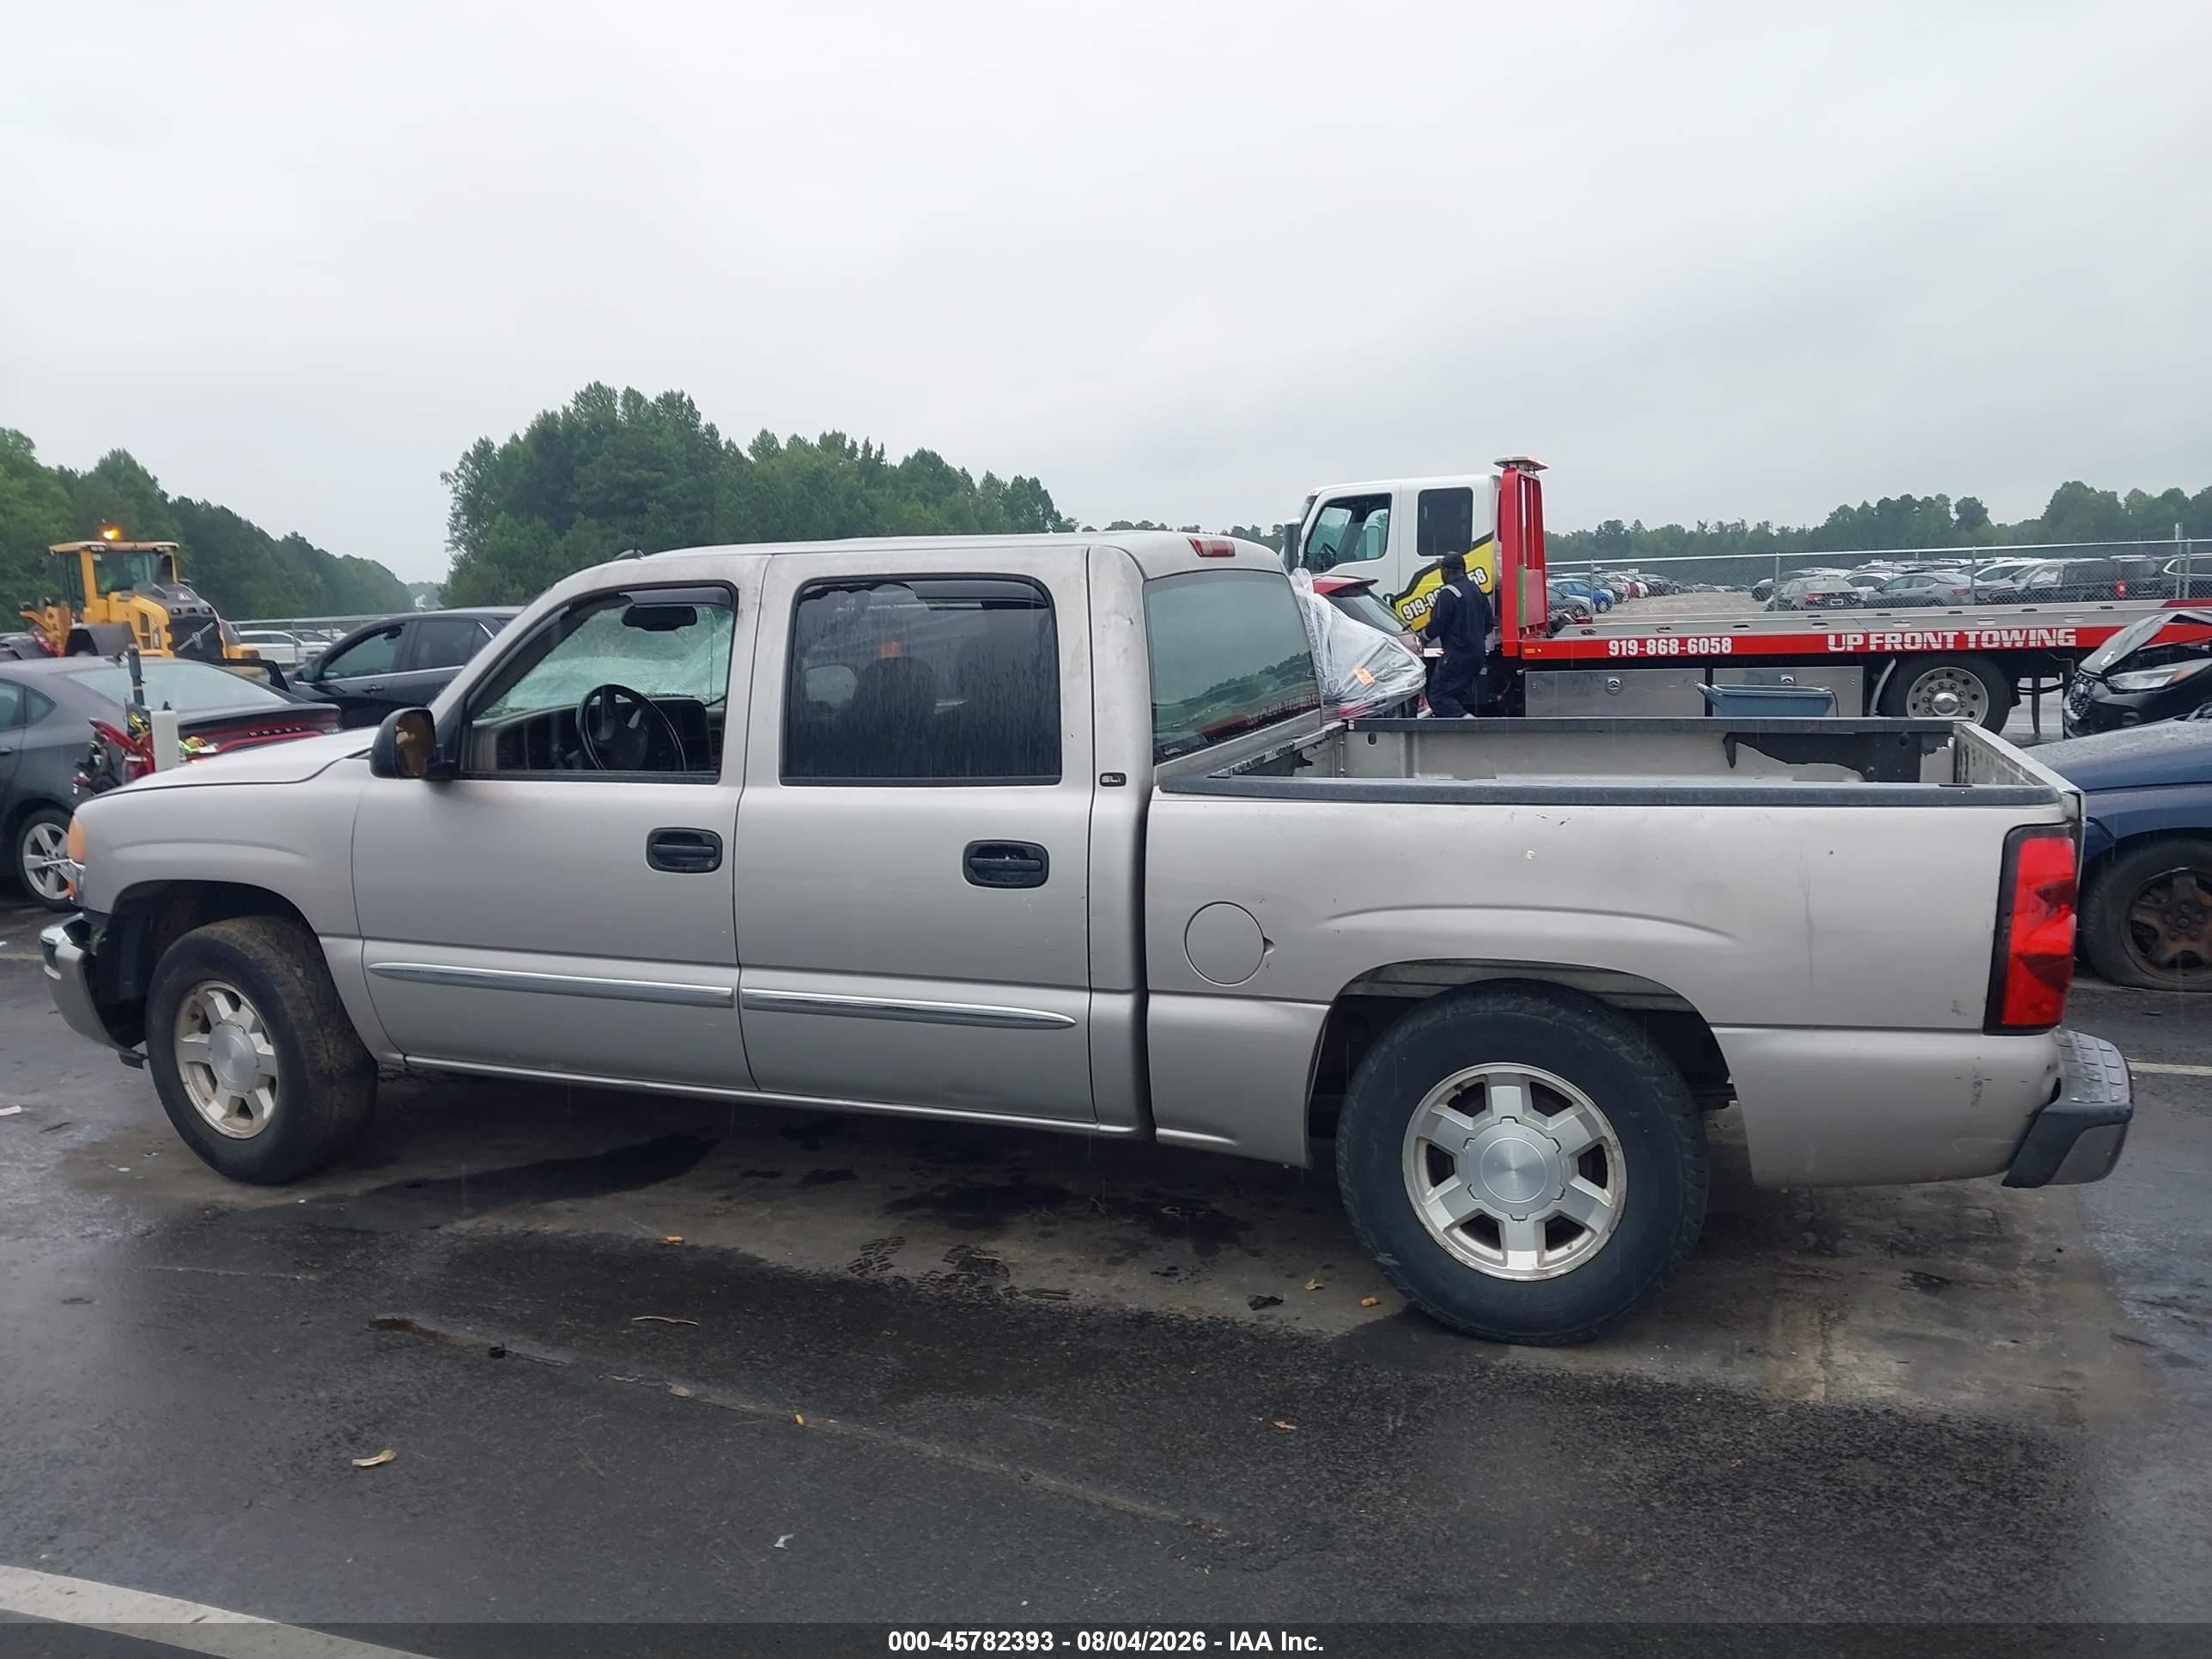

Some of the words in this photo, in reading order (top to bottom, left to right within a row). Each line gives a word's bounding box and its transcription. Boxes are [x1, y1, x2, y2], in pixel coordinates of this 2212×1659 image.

[1608, 636, 1733, 656] 919-868-6058
[1827, 634, 1864, 652] UP
[1869, 631, 1959, 651] FRONT
[1964, 628, 2076, 648] TOWING
